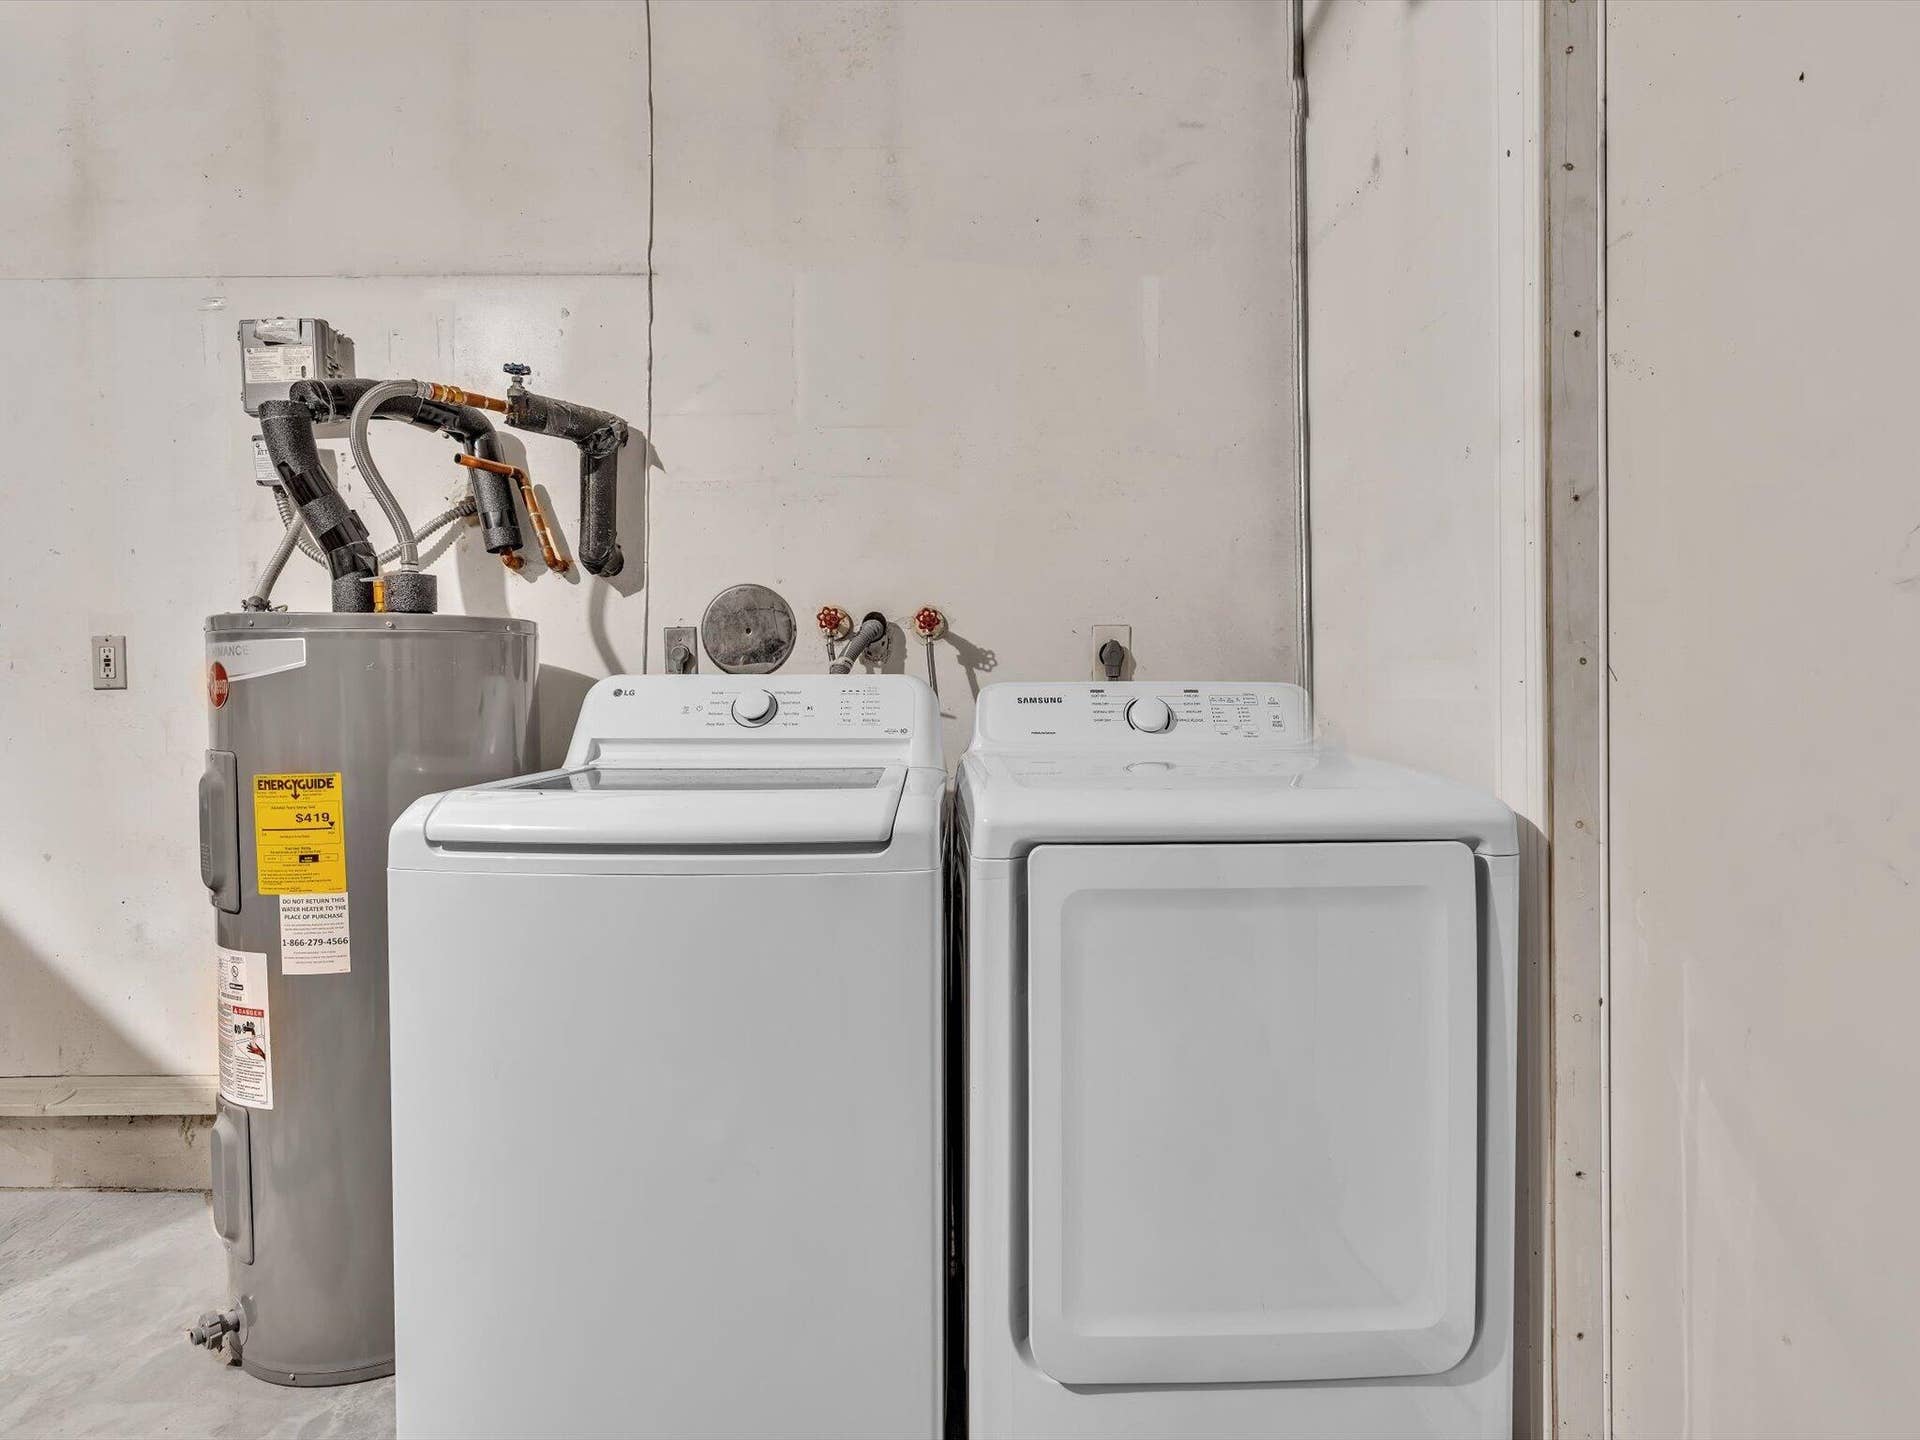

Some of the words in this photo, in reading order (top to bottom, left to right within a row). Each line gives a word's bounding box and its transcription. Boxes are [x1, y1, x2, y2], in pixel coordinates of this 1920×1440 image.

[623, 689, 636, 697] LG
[1017, 696, 1063, 704] SAMSUNG
[257, 777, 335, 792] ENERGYGUIDE
[282, 936, 349, 947] 1-866-279-4566
[239, 1008, 263, 1016] DANGER
